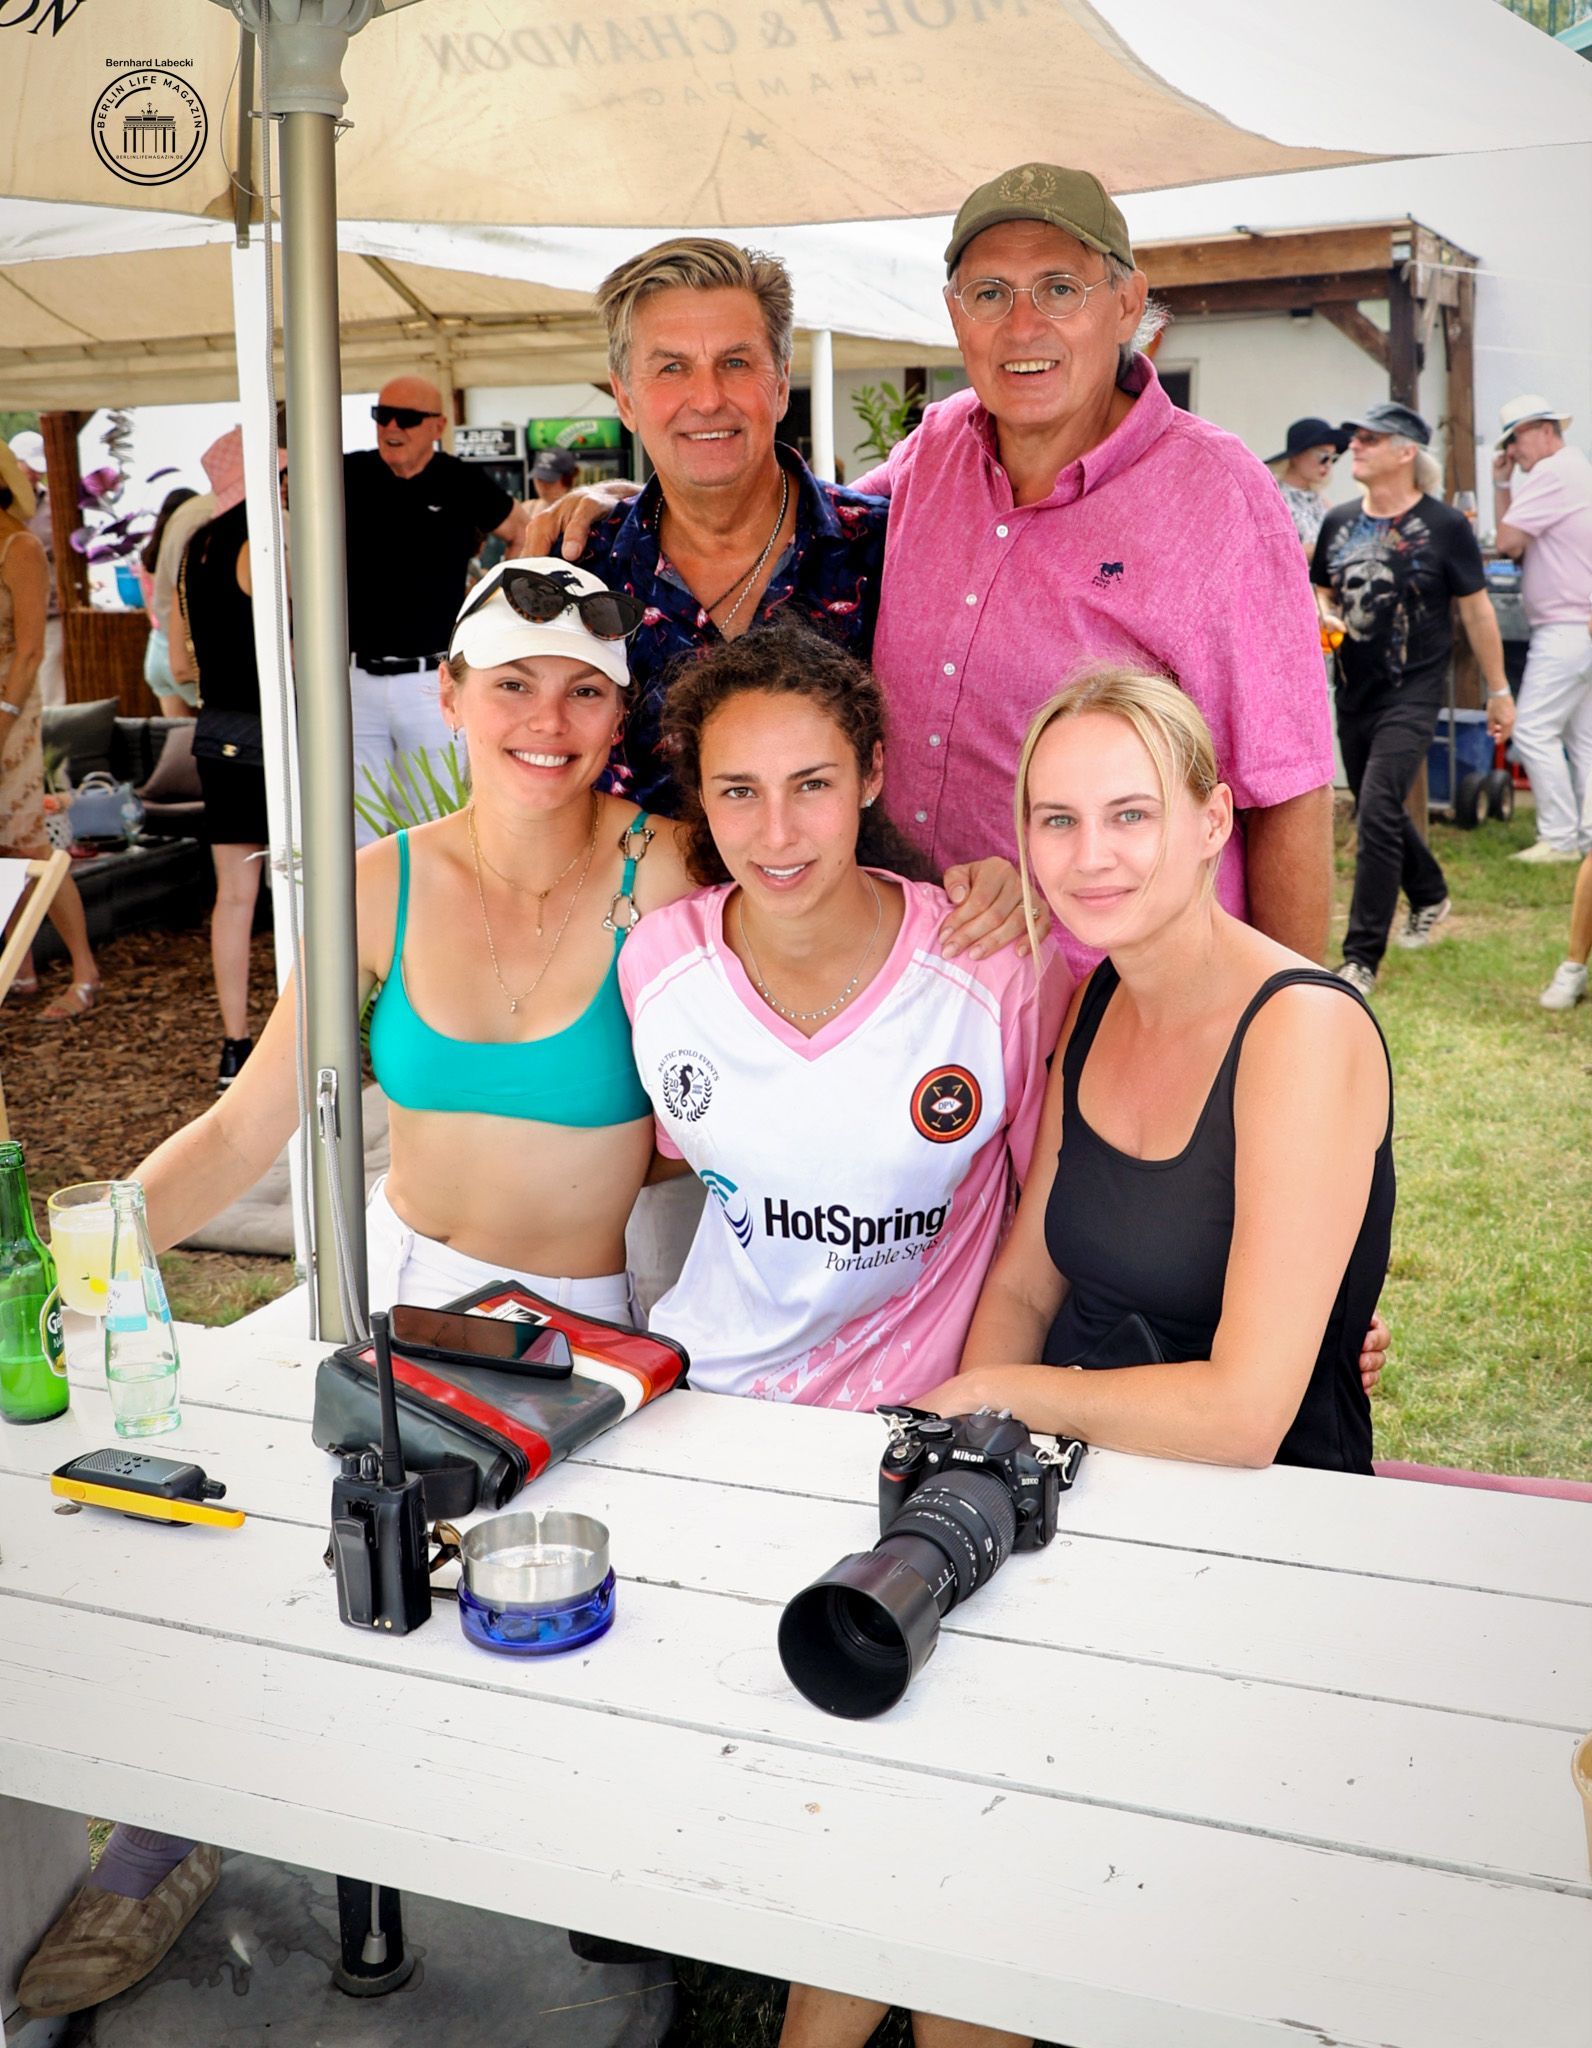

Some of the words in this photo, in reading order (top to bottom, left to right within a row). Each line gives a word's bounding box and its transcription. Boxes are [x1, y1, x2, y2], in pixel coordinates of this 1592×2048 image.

[658, 1050, 677, 1072] BALTIC
[678, 1049, 698, 1058] POLO
[699, 1054, 720, 1081] EVENTS
[764, 1197, 948, 1254] HotSpring
[825, 1248, 900, 1272] Portable
[902, 1236, 940, 1261] Spas
[952, 1450, 985, 1463] Nikon
